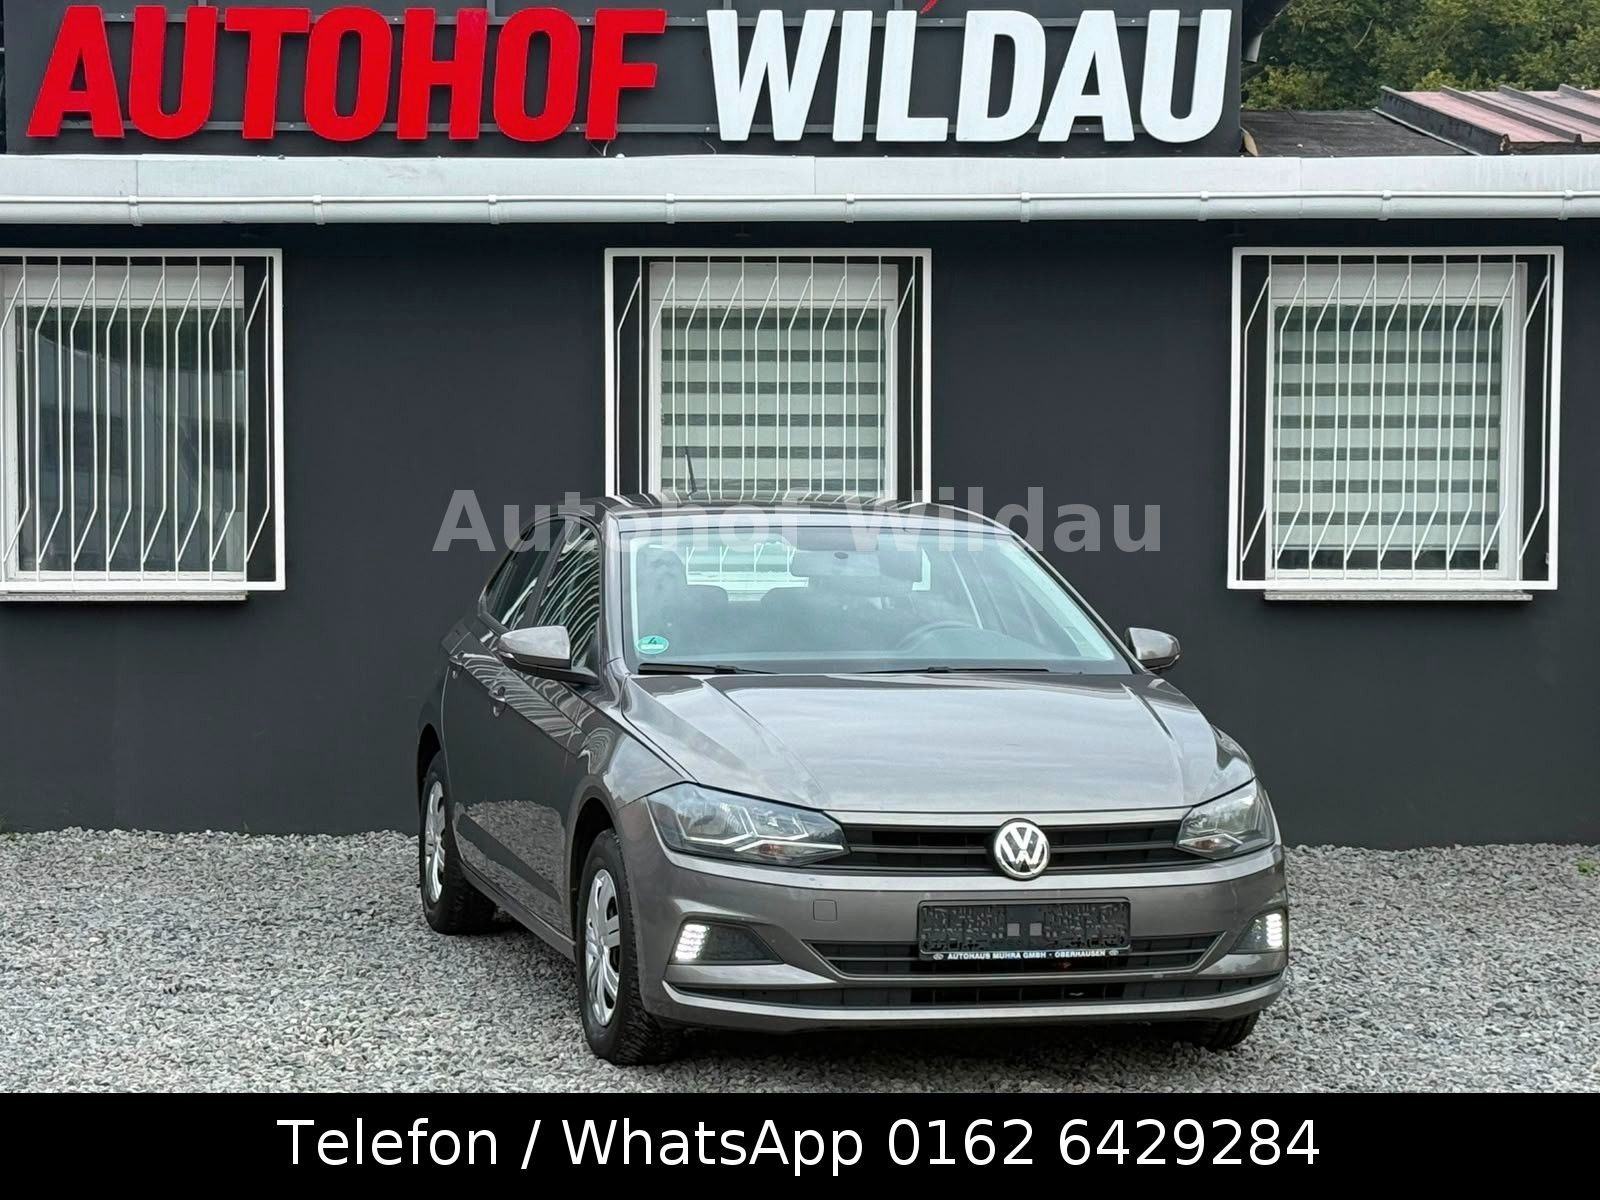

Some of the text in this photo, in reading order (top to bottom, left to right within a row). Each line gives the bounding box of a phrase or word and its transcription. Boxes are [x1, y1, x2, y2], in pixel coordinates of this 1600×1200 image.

[26, 5, 1232, 143] AUTOHOF WILDAU
[995, 822, 1048, 877] VW
[947, 952, 990, 961] AUTOHAUS
[1054, 950, 1106, 959] OBERHAUSEN
